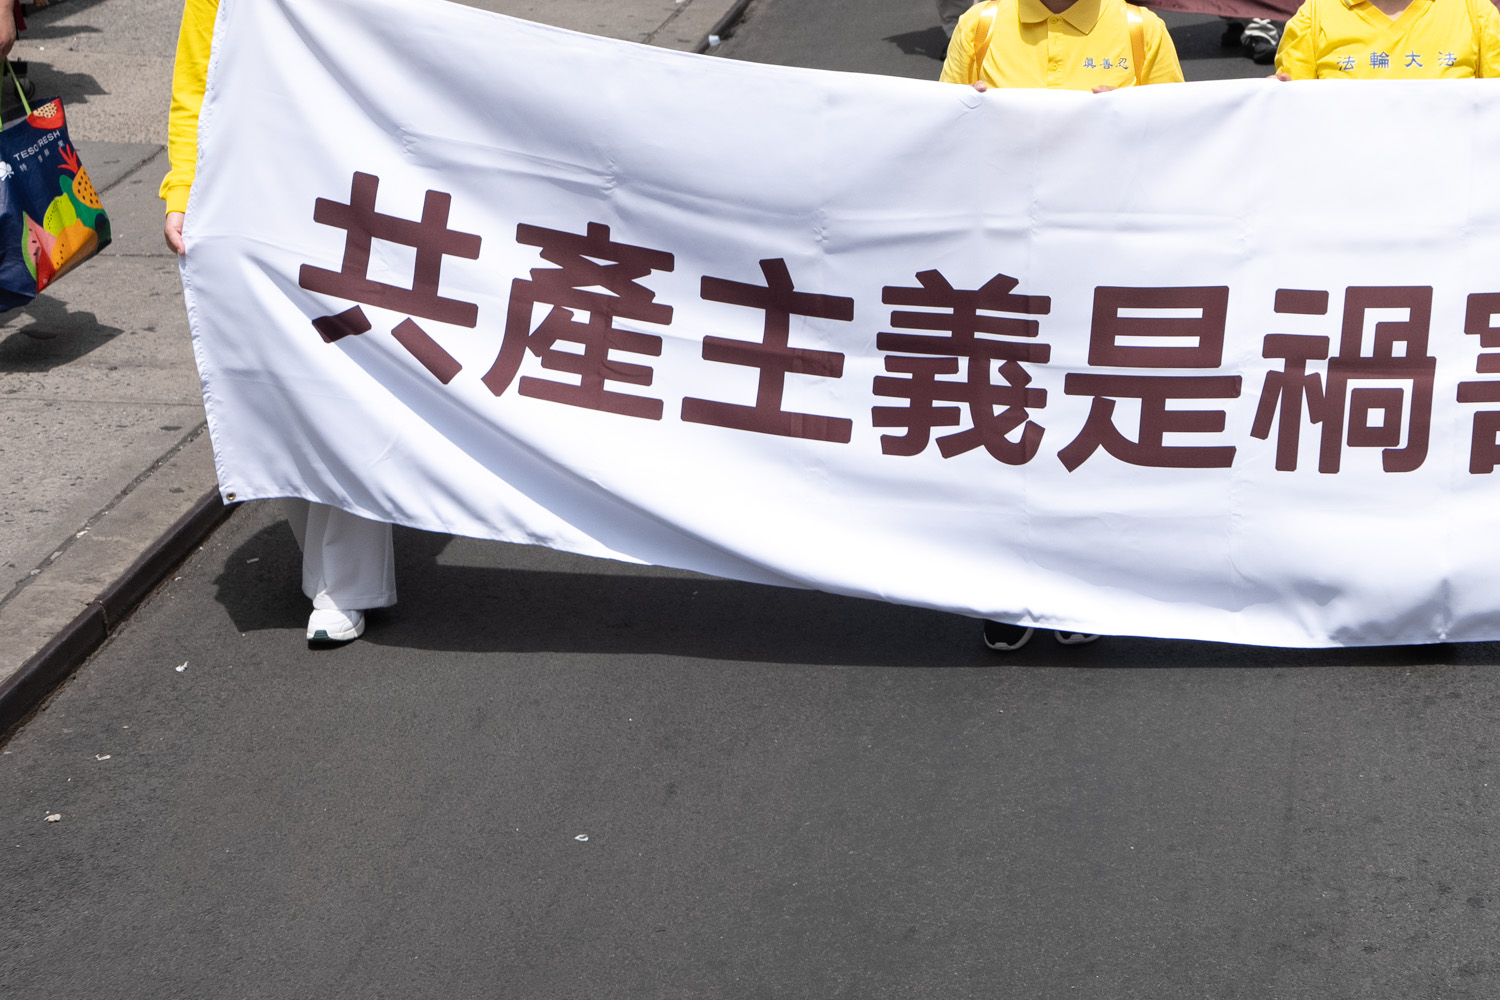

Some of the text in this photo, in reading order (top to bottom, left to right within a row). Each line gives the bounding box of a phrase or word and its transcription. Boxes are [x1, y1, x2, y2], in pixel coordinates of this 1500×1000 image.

[1336, 50, 1458, 72] 法輪大法
[13, 129, 61, 161] TESORESH
